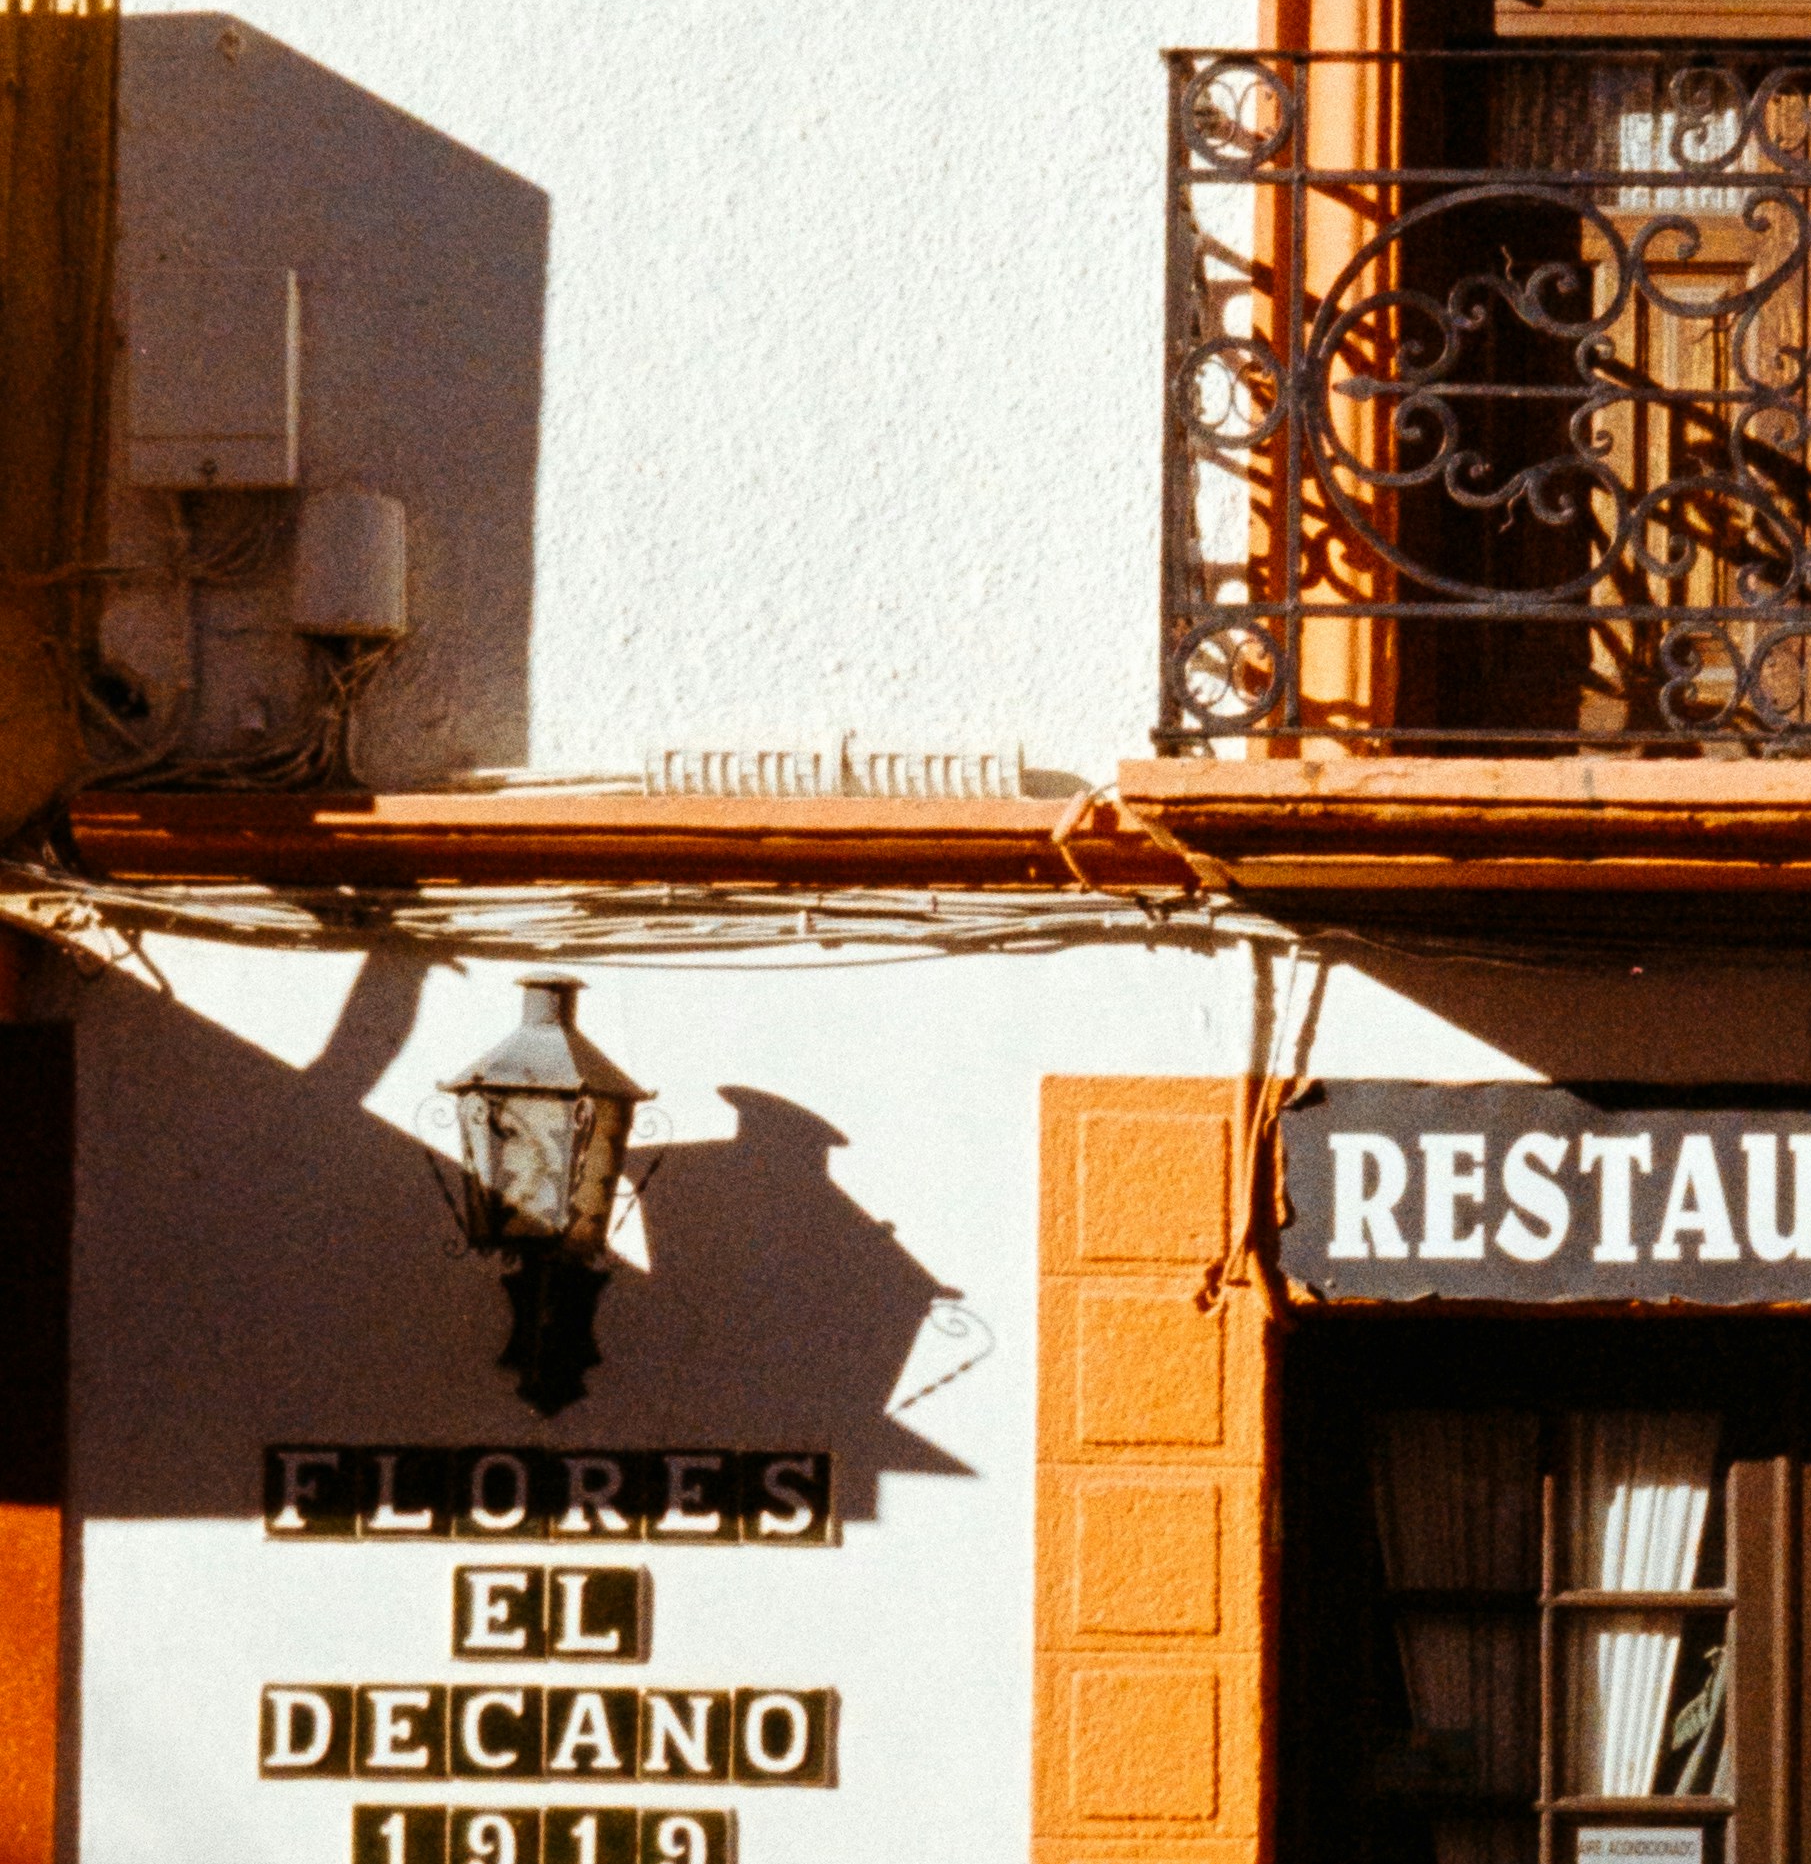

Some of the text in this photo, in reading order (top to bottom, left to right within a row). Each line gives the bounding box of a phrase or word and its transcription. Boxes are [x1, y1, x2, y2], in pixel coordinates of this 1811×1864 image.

[274, 1451, 818, 1535] FLORES
[462, 1571, 621, 1654] EL
[263, 1688, 810, 1775] DECANO
